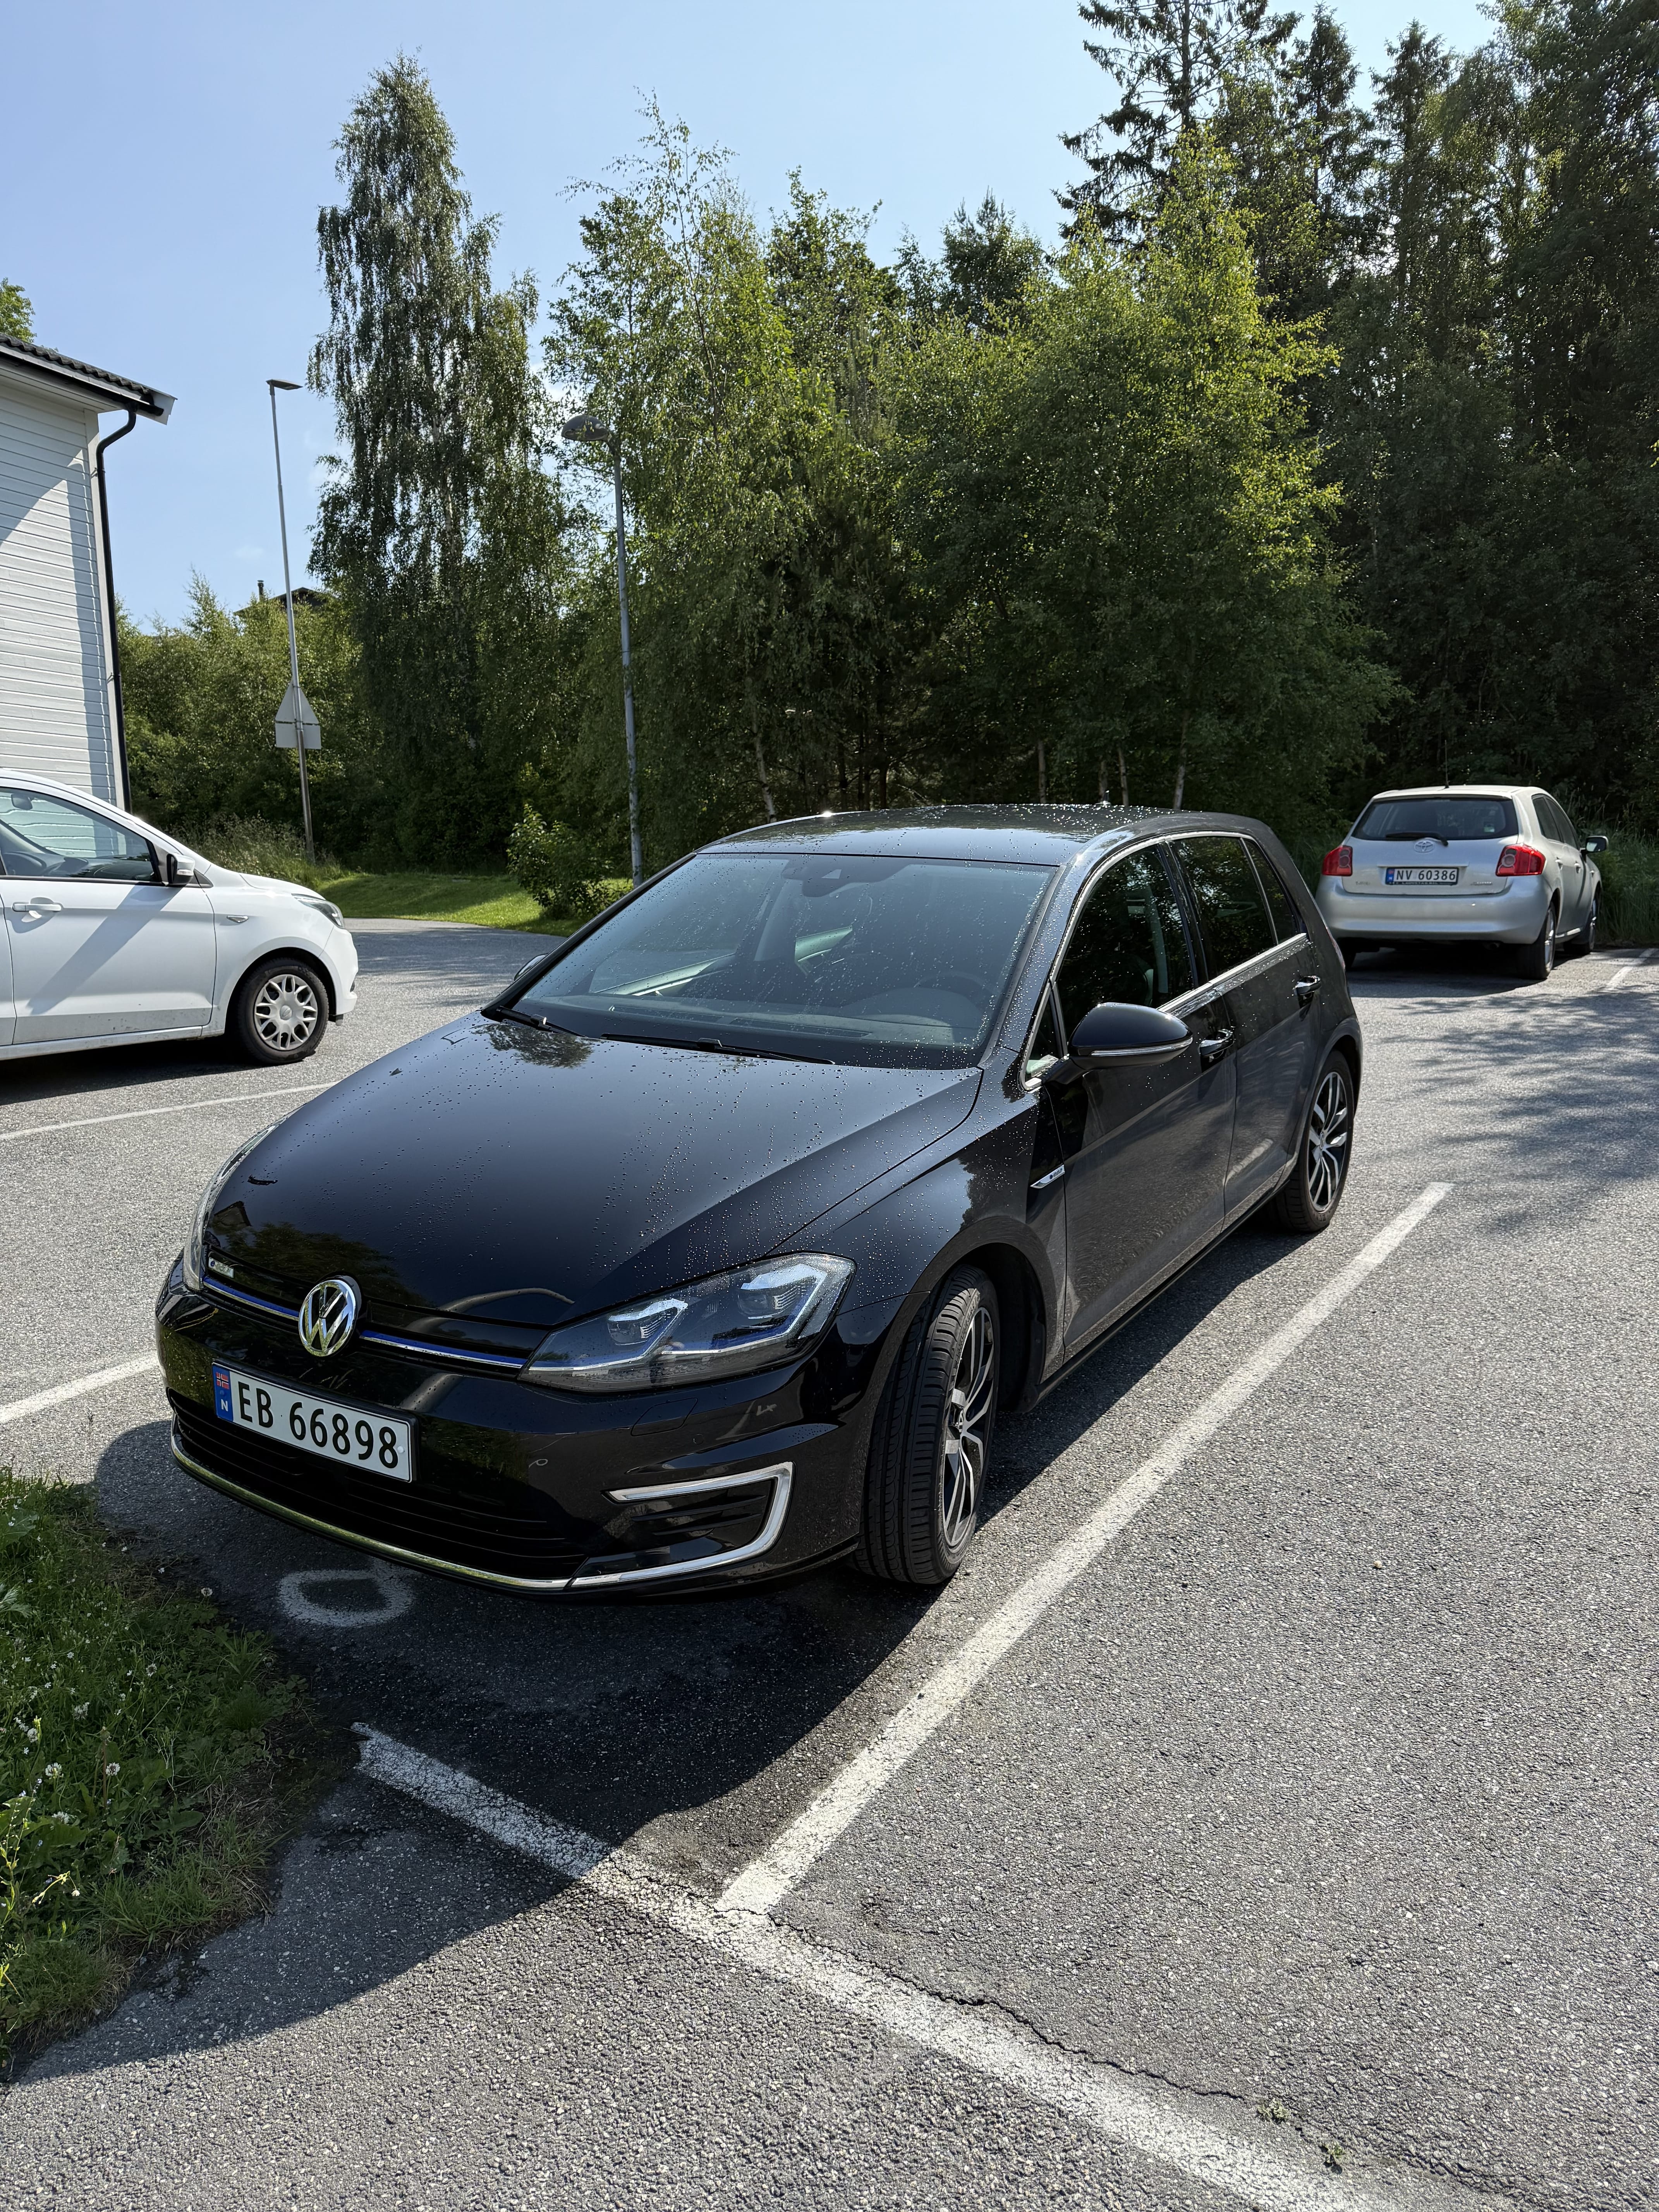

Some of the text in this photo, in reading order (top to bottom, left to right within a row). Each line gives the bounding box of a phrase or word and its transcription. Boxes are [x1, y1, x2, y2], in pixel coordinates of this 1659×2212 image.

[1396, 870, 1456, 881] NV 60386
[299, 1280, 356, 1356] VW
[221, 1398, 228, 1412] N
[238, 1381, 398, 1468] EB 66898
